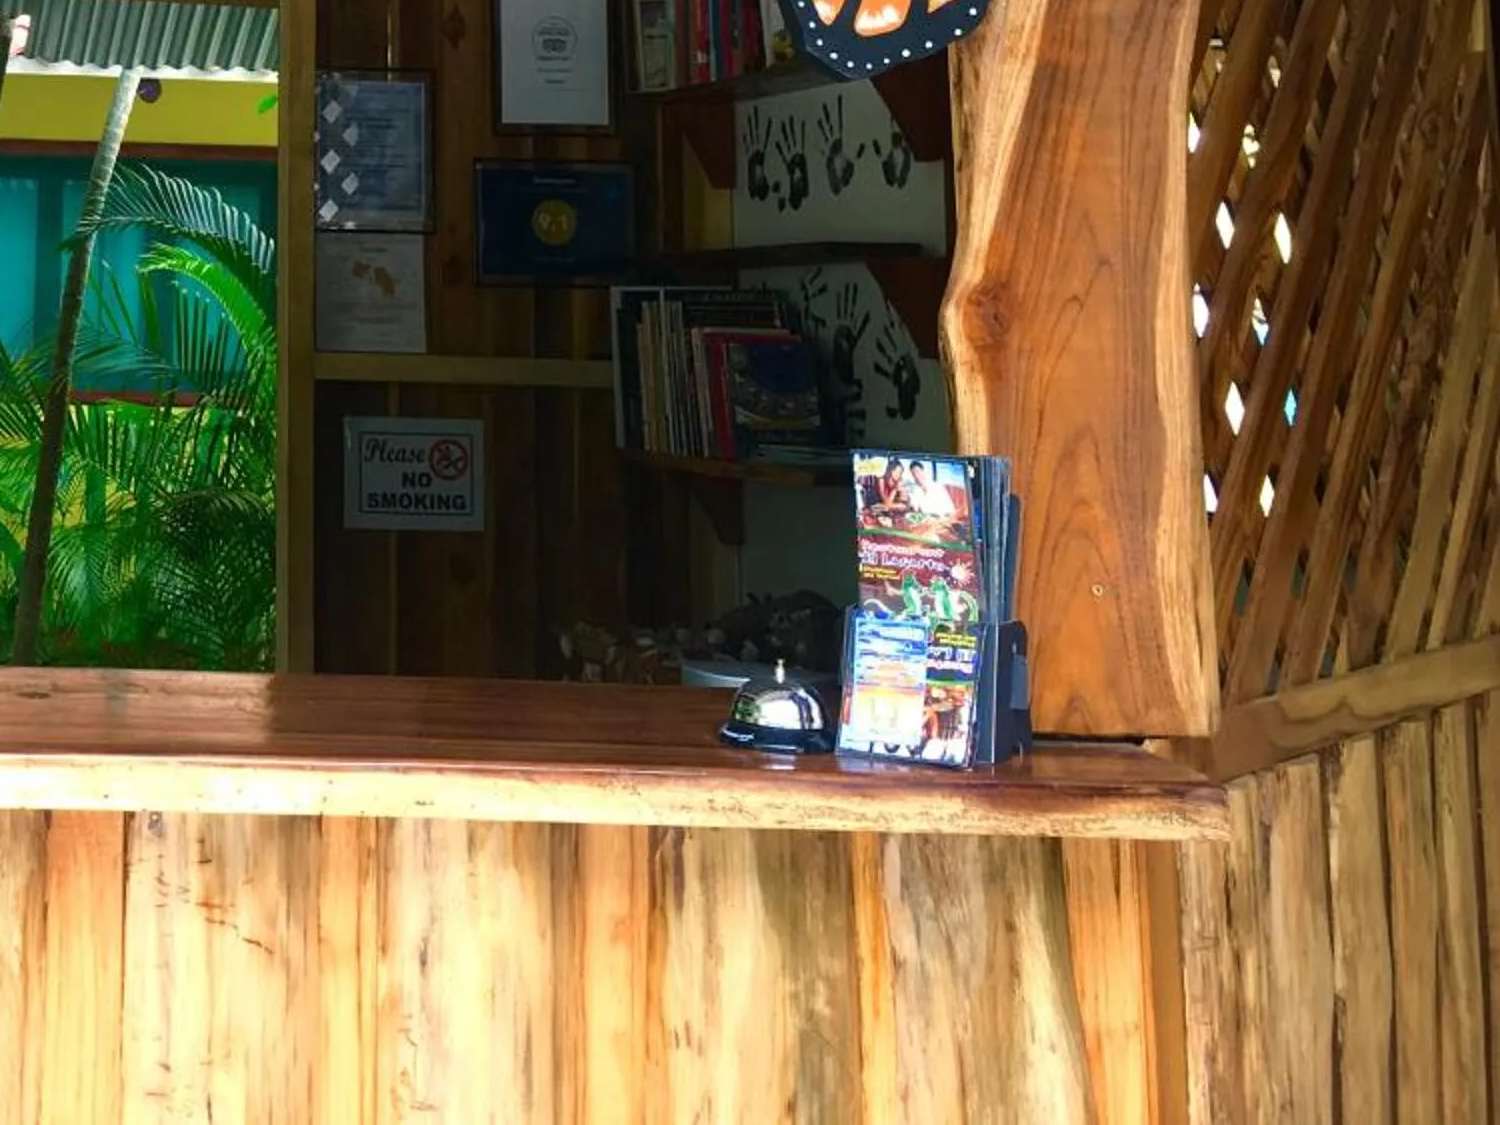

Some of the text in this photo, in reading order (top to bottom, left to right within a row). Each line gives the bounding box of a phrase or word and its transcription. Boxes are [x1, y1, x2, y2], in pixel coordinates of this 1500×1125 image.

[363, 437, 426, 464] Please
[401, 472, 433, 488] NO
[367, 492, 468, 511] SMOKING
